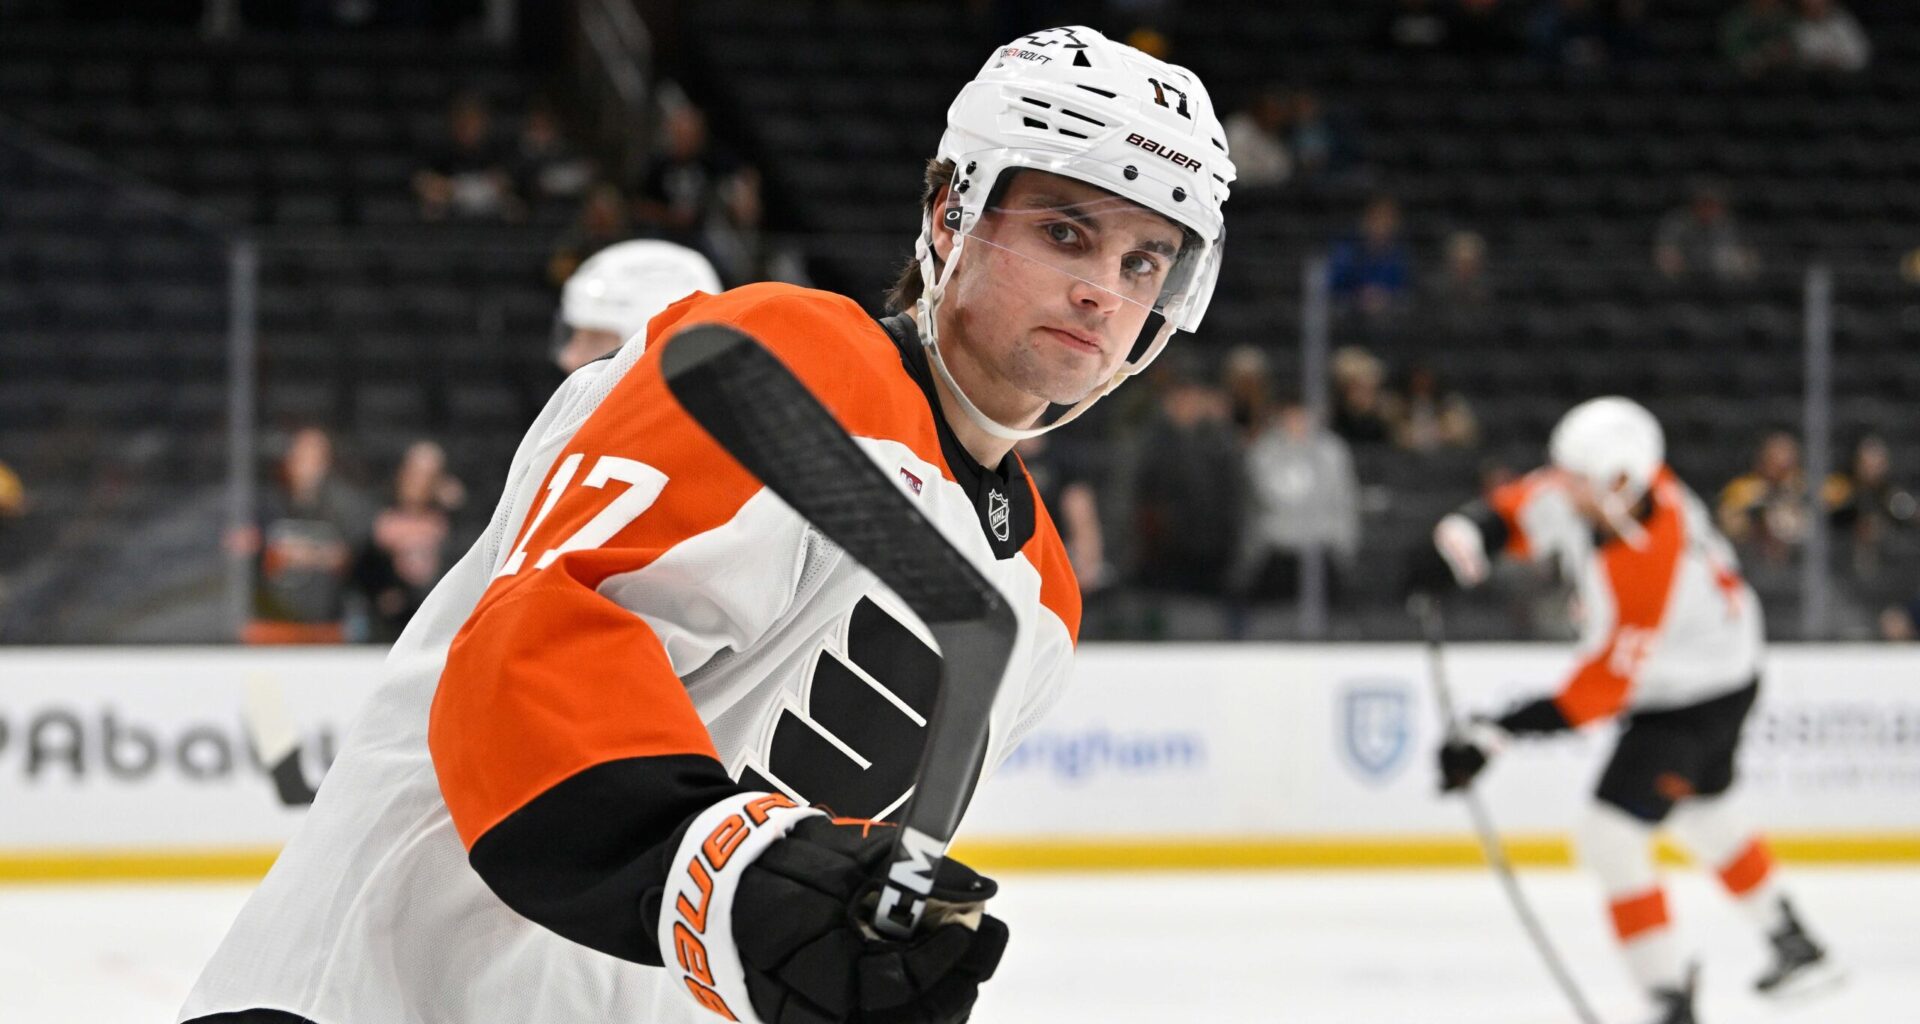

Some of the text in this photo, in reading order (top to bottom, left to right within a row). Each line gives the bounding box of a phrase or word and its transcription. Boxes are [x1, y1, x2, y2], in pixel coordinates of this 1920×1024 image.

[1147, 77, 1191, 120] 17
[499, 453, 670, 575] 17
[992, 508, 1006, 526] NHL
